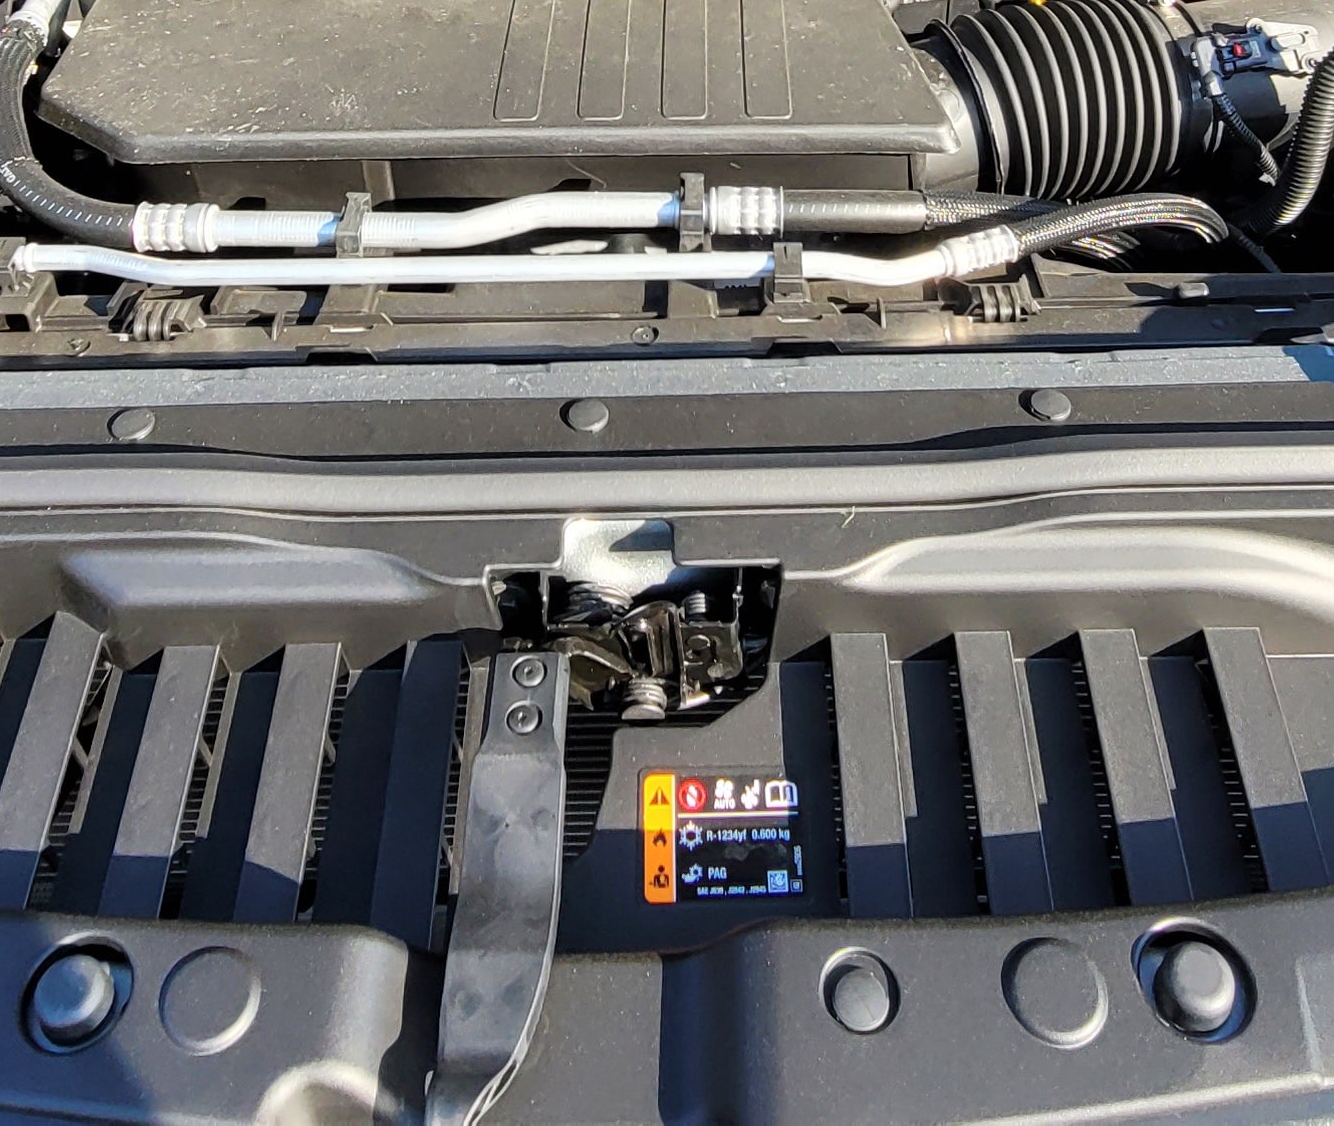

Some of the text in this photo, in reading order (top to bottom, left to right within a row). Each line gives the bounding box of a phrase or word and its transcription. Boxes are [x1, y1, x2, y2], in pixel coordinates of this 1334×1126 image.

[714, 797, 736, 810] AUTO
[706, 828, 791, 843] R-1234yf 0.600 kg
[707, 866, 727, 879] PAG
